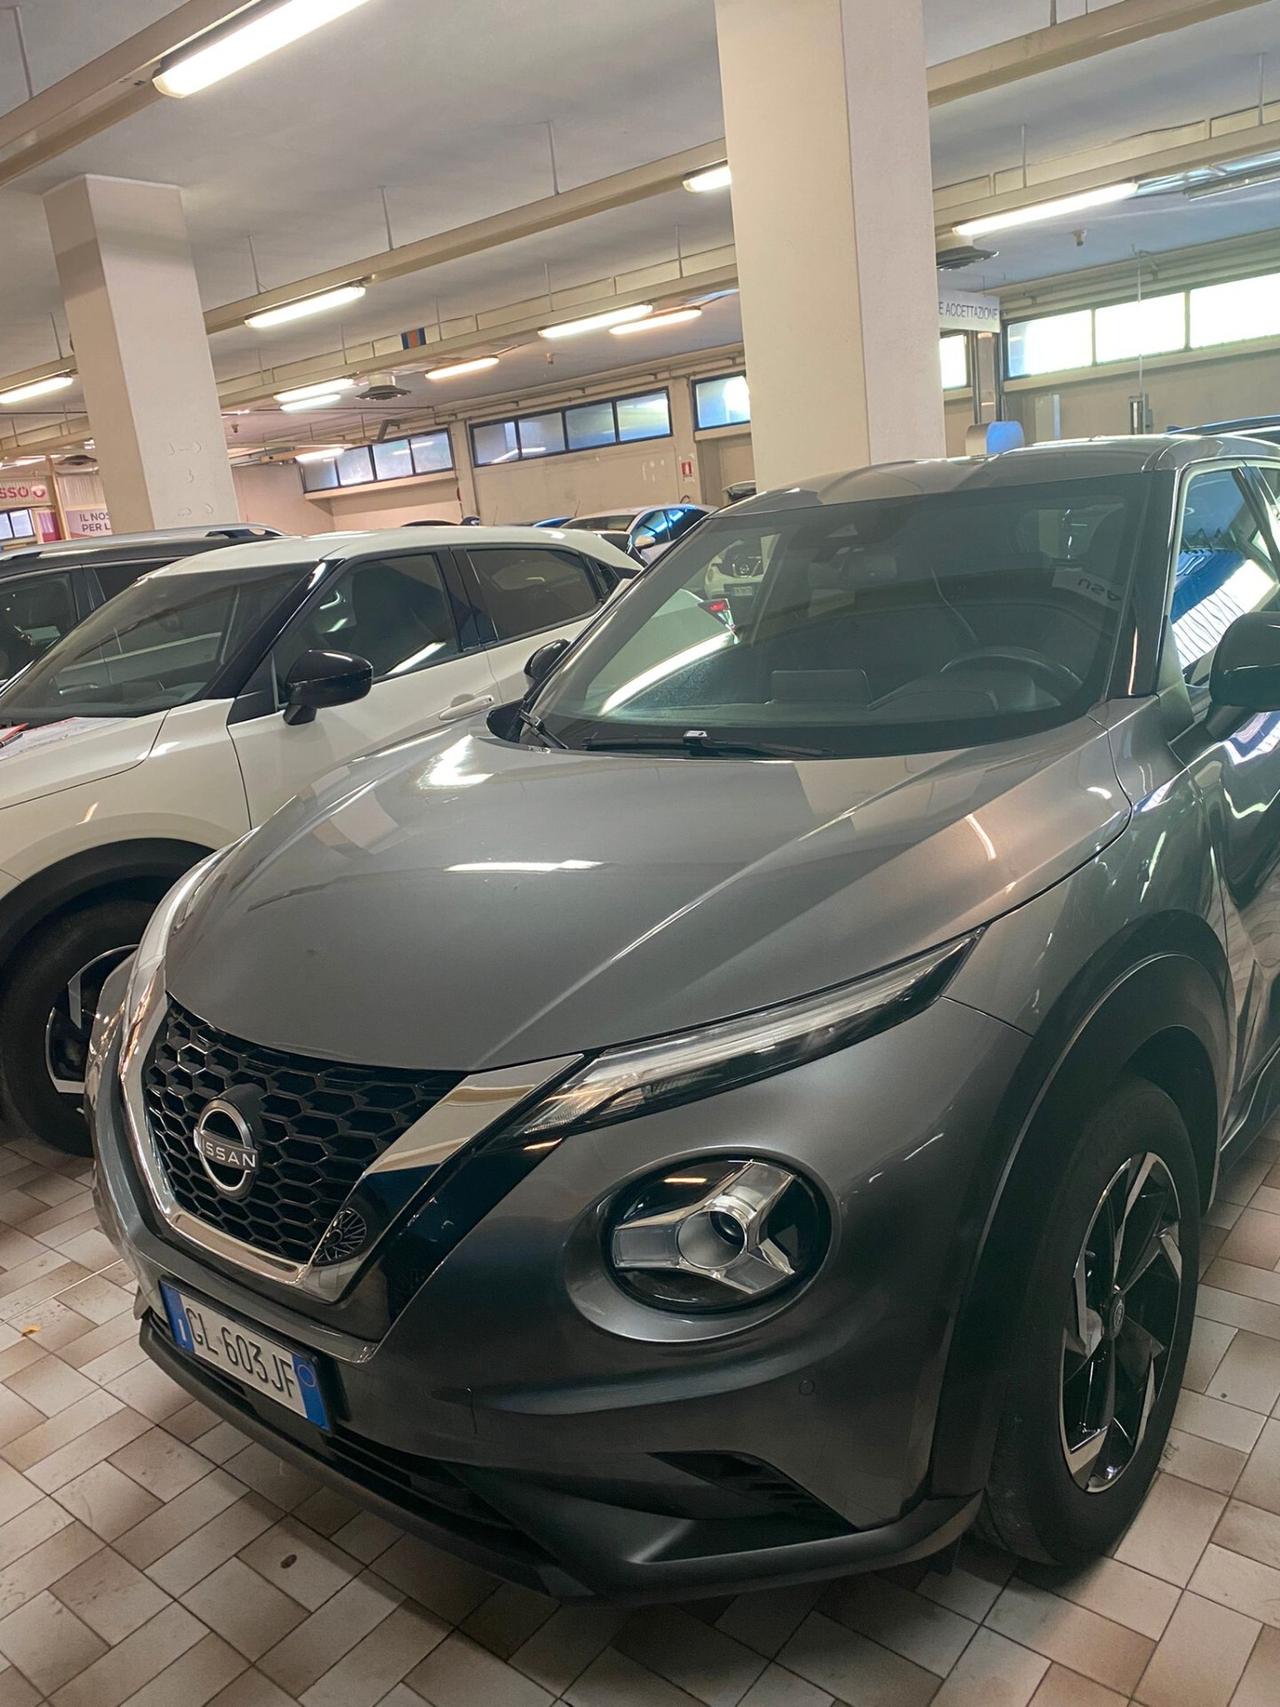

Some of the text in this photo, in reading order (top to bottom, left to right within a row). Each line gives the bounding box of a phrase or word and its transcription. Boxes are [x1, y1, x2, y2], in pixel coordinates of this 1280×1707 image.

[945, 302, 999, 320] ACCETTAZIONE
[80, 513, 89, 522] IL
[82, 523, 102, 532] PER
